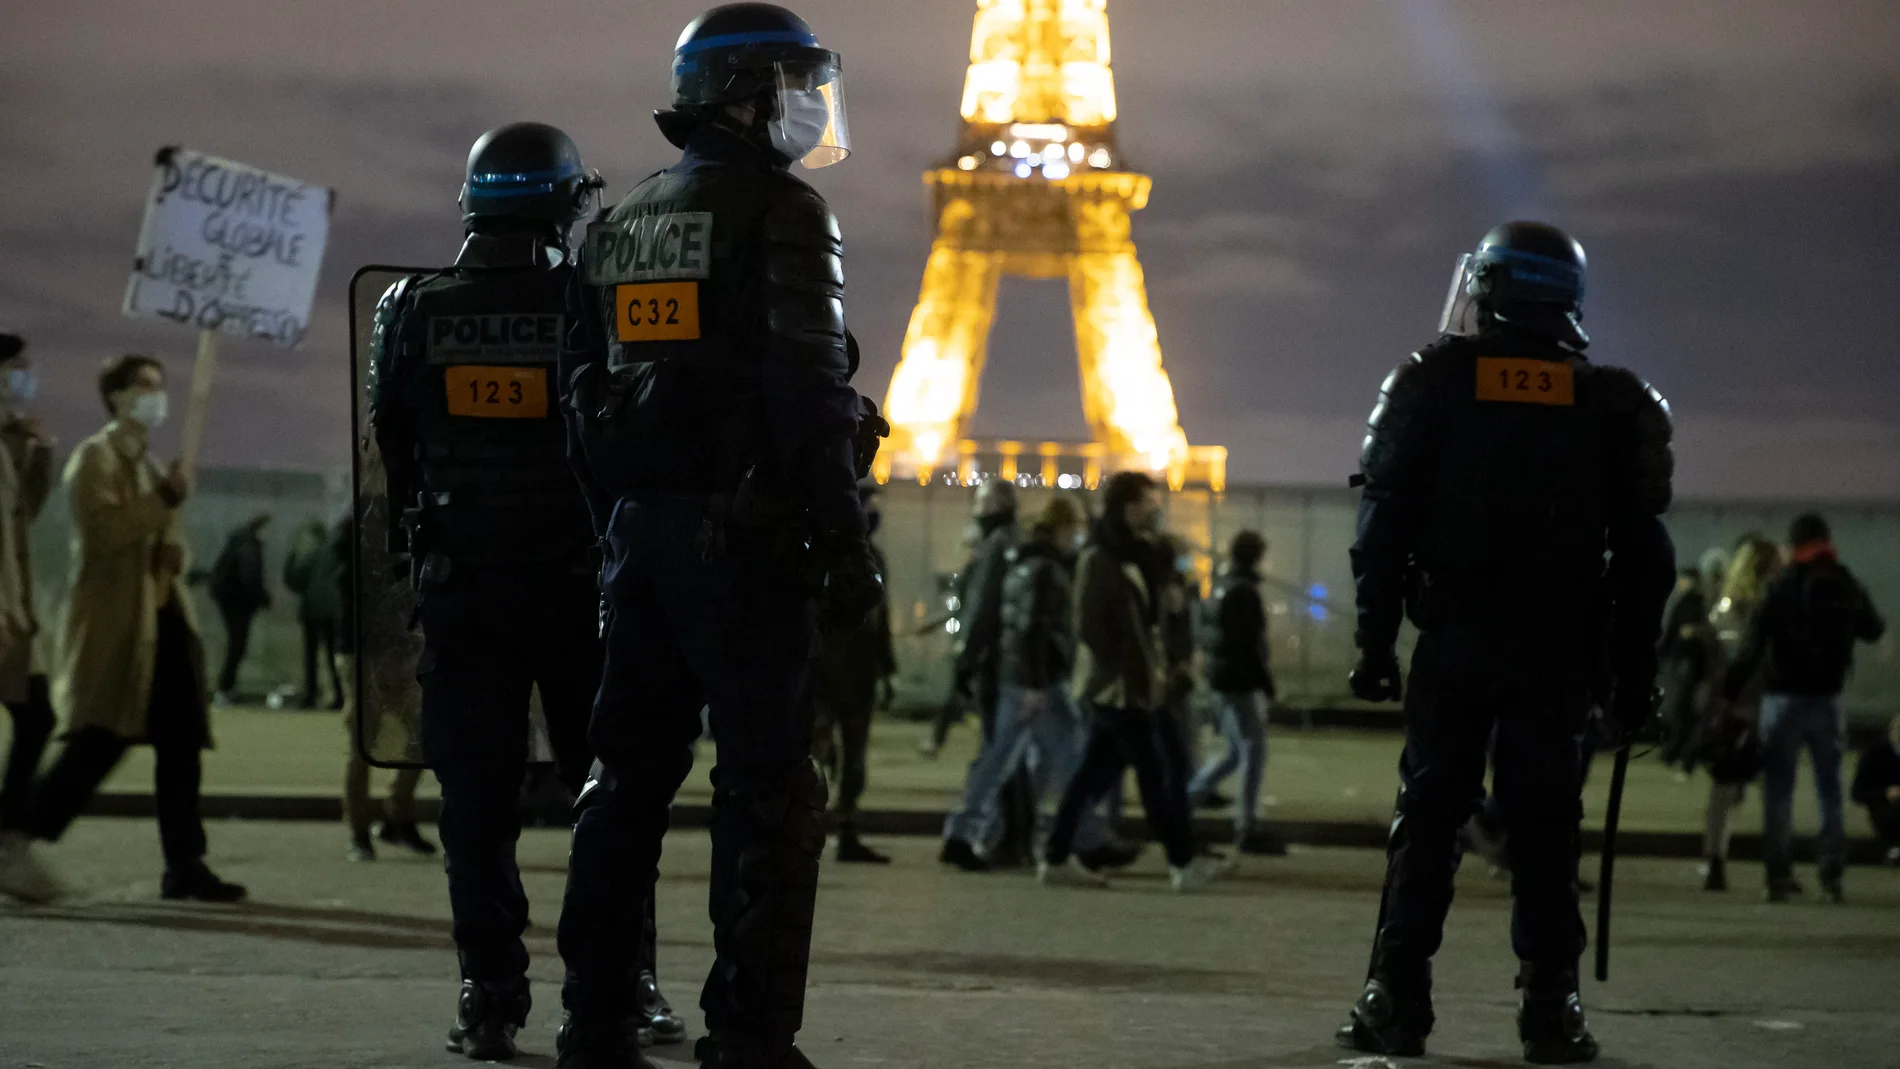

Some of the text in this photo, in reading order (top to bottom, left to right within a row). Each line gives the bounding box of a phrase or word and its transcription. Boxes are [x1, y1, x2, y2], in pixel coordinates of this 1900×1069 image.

[595, 222, 702, 276] POLICE
[628, 298, 680, 326] C32
[433, 316, 558, 346] POLICE
[470, 380, 522, 404] 123
[1499, 368, 1552, 392] 123
